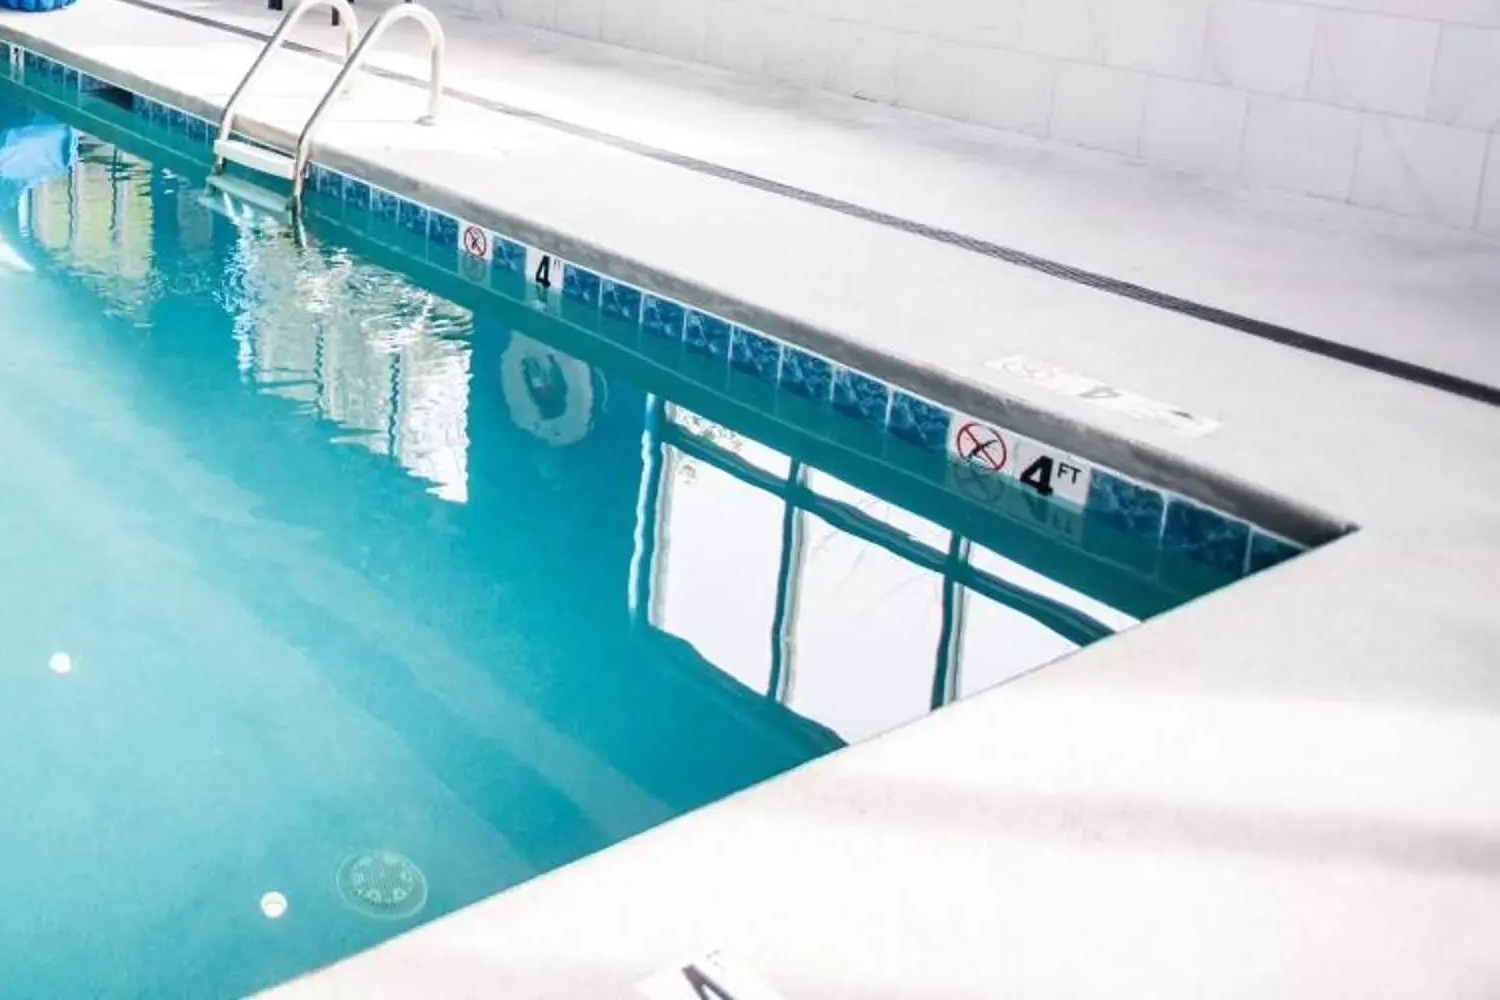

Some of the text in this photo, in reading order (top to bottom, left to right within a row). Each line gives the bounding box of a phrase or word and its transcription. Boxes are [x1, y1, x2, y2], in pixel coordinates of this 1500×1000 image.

[535, 255, 551, 288] 4
[1020, 456, 1082, 496] 4 FT
